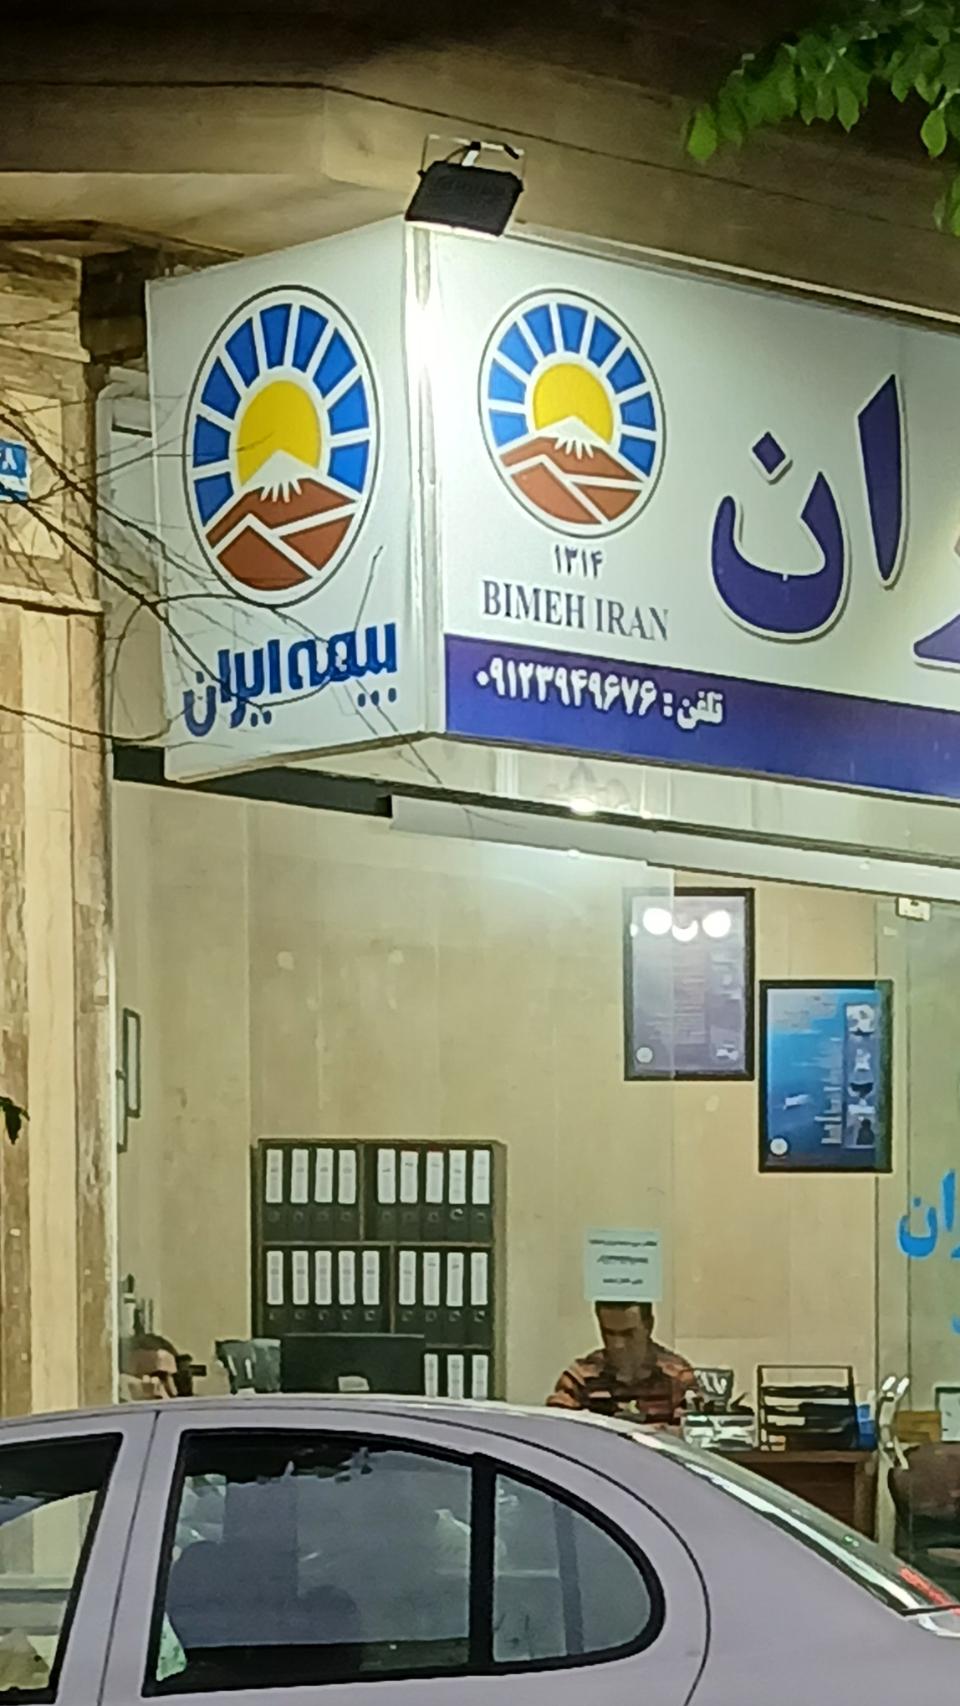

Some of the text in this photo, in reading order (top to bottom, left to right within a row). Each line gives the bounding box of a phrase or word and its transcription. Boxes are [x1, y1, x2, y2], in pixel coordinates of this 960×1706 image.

[554, 544, 604, 580] ۱۳۱۴
[483, 579, 669, 641] BIMEH IRAN
[182, 622, 397, 737] بیمه ایران
[475, 656, 657, 717] ۰۹۱۲۳۹۴۹۶۷۶
